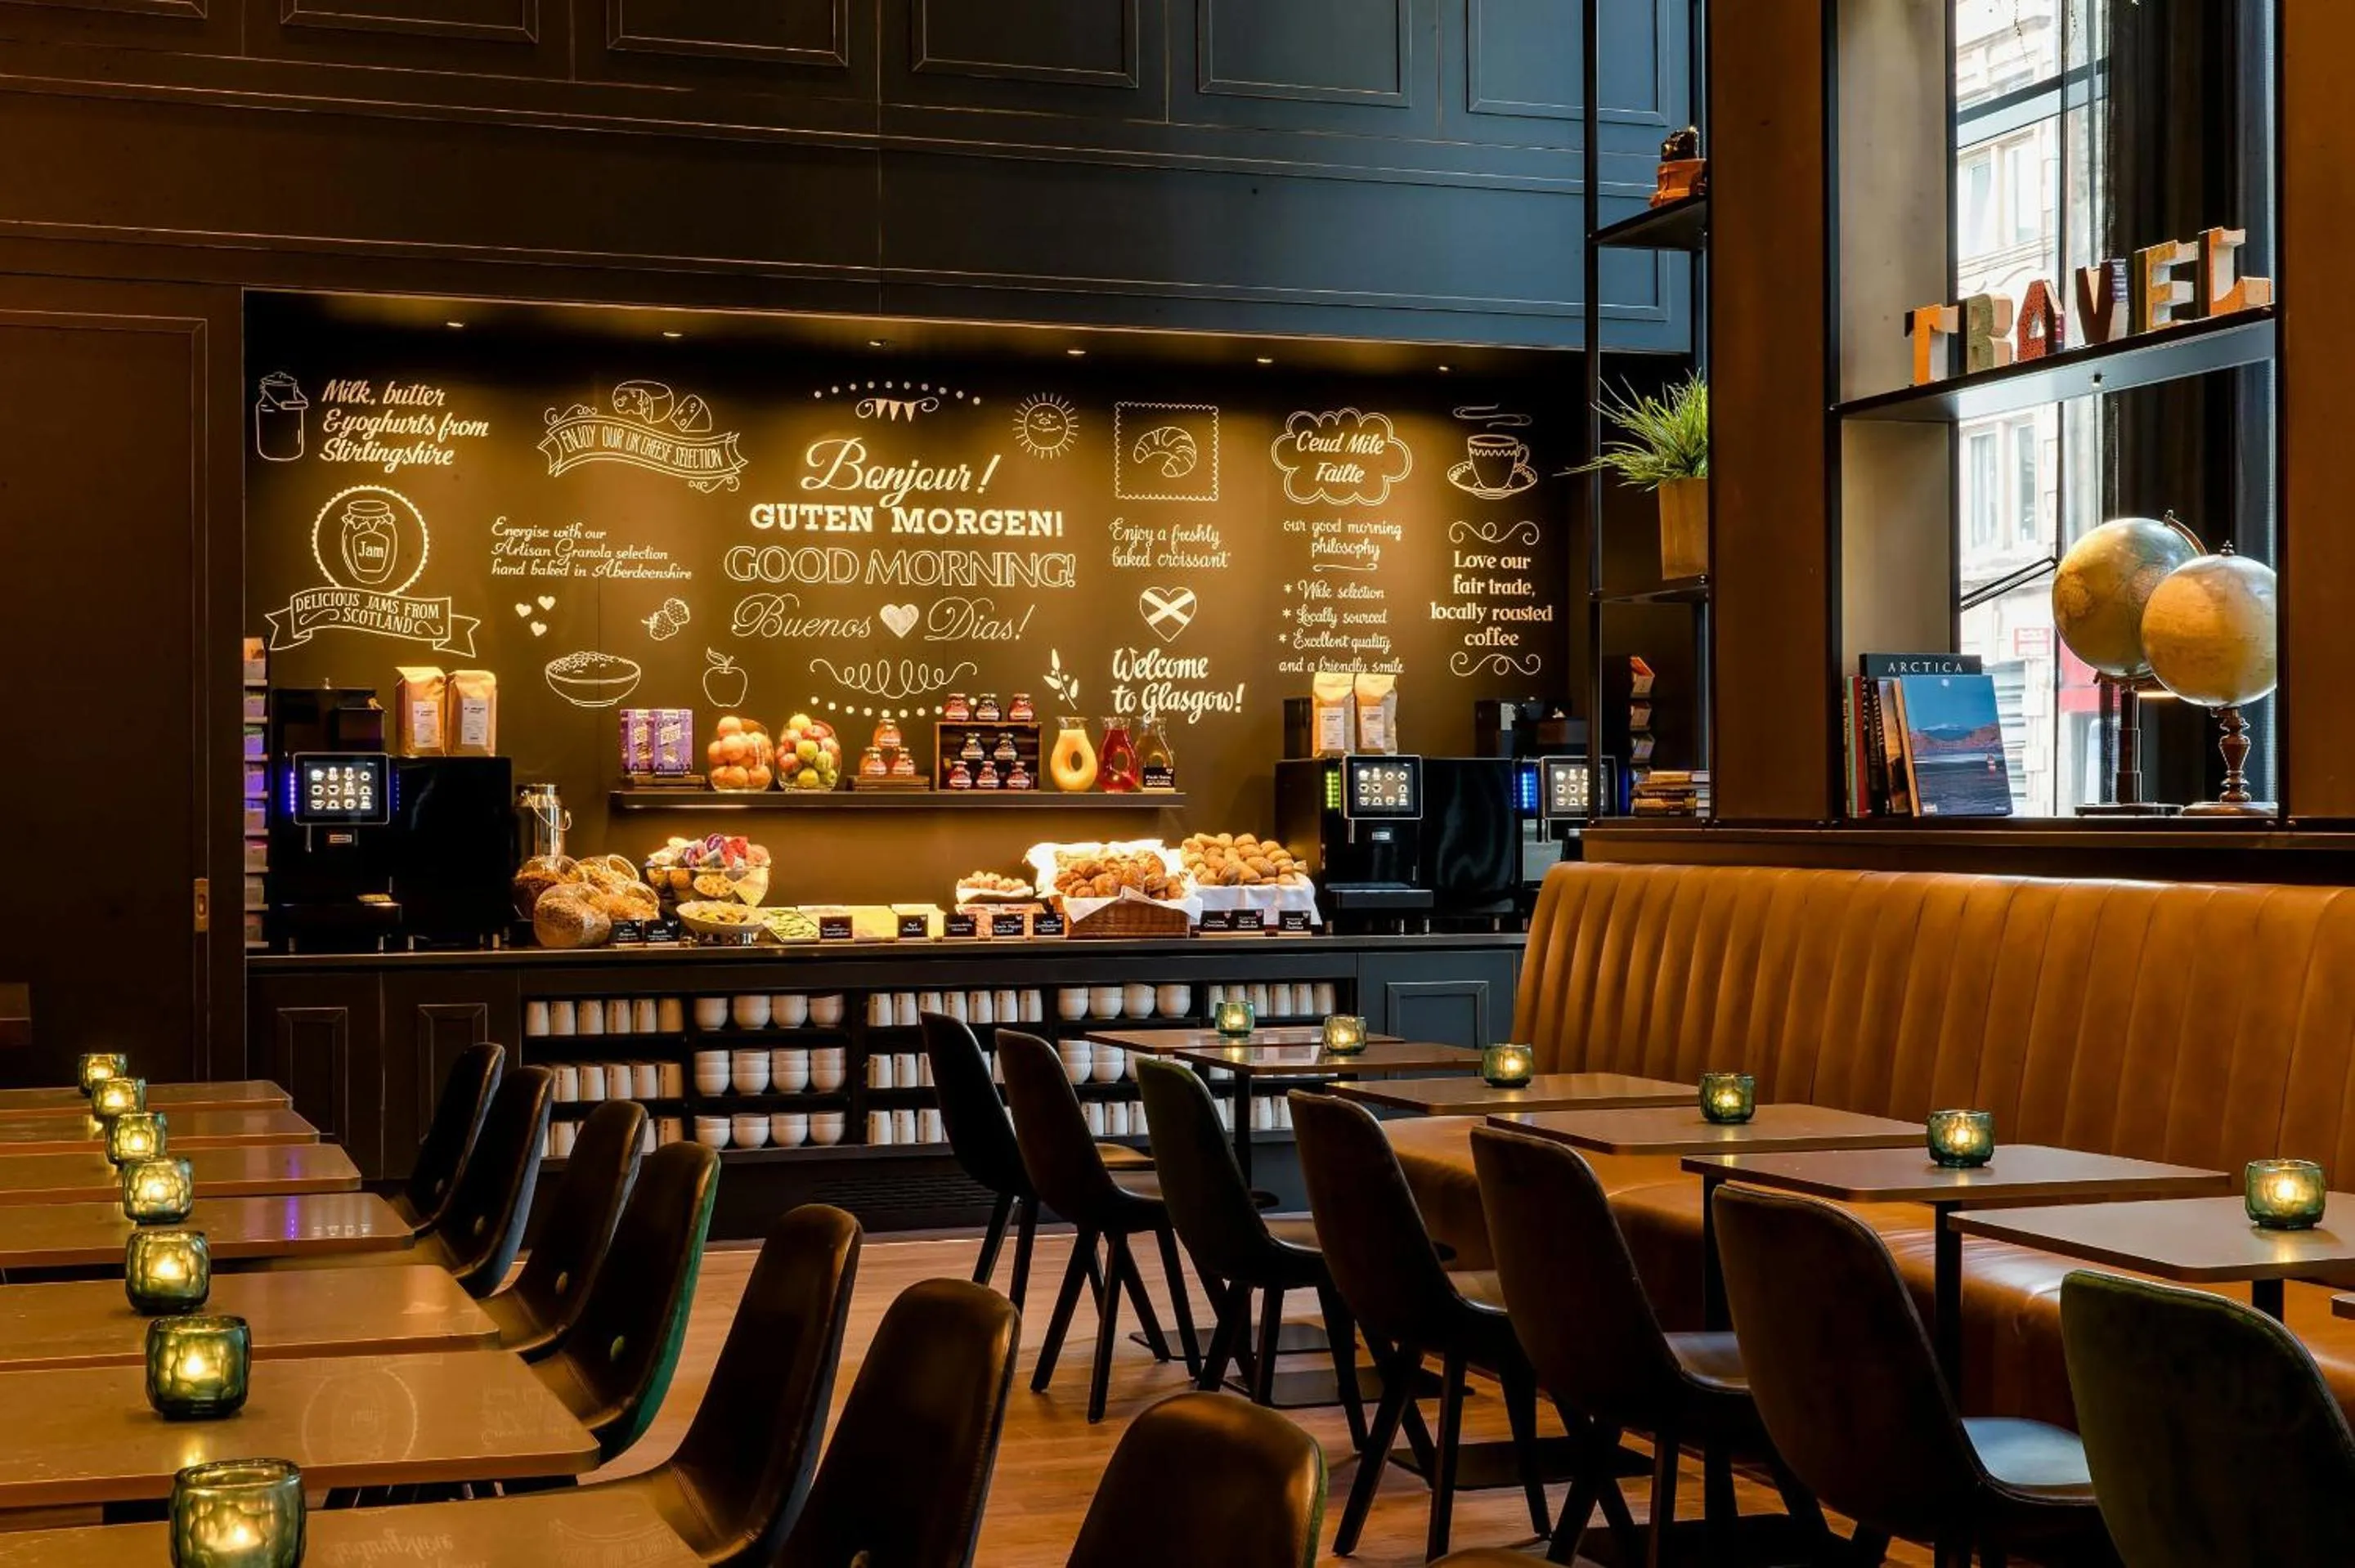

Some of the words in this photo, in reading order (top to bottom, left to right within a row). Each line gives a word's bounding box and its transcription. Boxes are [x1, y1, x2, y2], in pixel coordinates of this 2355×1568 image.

[1904, 226, 2271, 388] TRAVEL
[321, 379, 376, 405] Milk,
[383, 381, 446, 407] butter
[437, 412, 490, 443] from
[560, 425, 596, 453] ENJOY
[602, 425, 624, 448] OUR
[640, 437, 672, 463] CHEESE
[672, 446, 724, 469] SELECTION
[1296, 430, 1345, 453] Ceud
[319, 438, 455, 473] Stirlingshire
[491, 516, 550, 541] Energise
[554, 522, 583, 539] with
[585, 530, 607, 540] our
[750, 504, 873, 533] GUTEN
[891, 507, 1063, 537] MORGEN!
[1283, 521, 1306, 532] our
[1312, 518, 1342, 538] good
[1348, 521, 1402, 540] morning
[1108, 517, 1155, 548] Enjoy
[1158, 528, 1167, 540] a
[1170, 524, 1222, 555] freshly
[1311, 537, 1380, 561] philosophy
[358, 541, 384, 558] Jam
[491, 536, 551, 557] Artisan
[555, 538, 612, 566] Granola
[616, 544, 667, 560] selection
[1111, 545, 1152, 567] baked
[1157, 550, 1231, 568] croissant
[1454, 550, 1496, 569] Love
[1500, 556, 1532, 570] our
[491, 558, 526, 576] hand
[531, 560, 570, 577] baked
[574, 564, 586, 576] in
[592, 558, 692, 580] Aberdeenshire
[724, 545, 859, 584] GOOD
[865, 549, 1076, 588] MORNING!
[1298, 579, 1332, 600] Wide
[1337, 581, 1384, 599] selection
[1452, 574, 1486, 595] fair
[1488, 577, 1536, 598] trade,
[295, 591, 361, 612] DELICIOUS
[366, 594, 400, 613] JAMS
[404, 601, 440, 619] FROM
[731, 594, 872, 638] Buenos
[924, 597, 1036, 642] Dias!
[1296, 603, 1337, 629] Locally
[1343, 608, 1388, 624] sourced
[1430, 602, 1487, 625] locally
[1492, 603, 1554, 622] roasted
[342, 607, 413, 634] SCOTLAND
[1293, 627, 1350, 649] Excellent
[1351, 632, 1392, 654] quality
[1464, 628, 1519, 647] coffee
[1112, 647, 1209, 681] Welcome
[1279, 656, 1303, 672] and
[1307, 661, 1315, 672] a
[1319, 656, 1367, 673] friendly
[1371, 656, 1404, 673] smile
[1888, 661, 1963, 674] ARCTICA
[1111, 683, 1137, 713] to
[1142, 683, 1245, 725] Glasgow!
